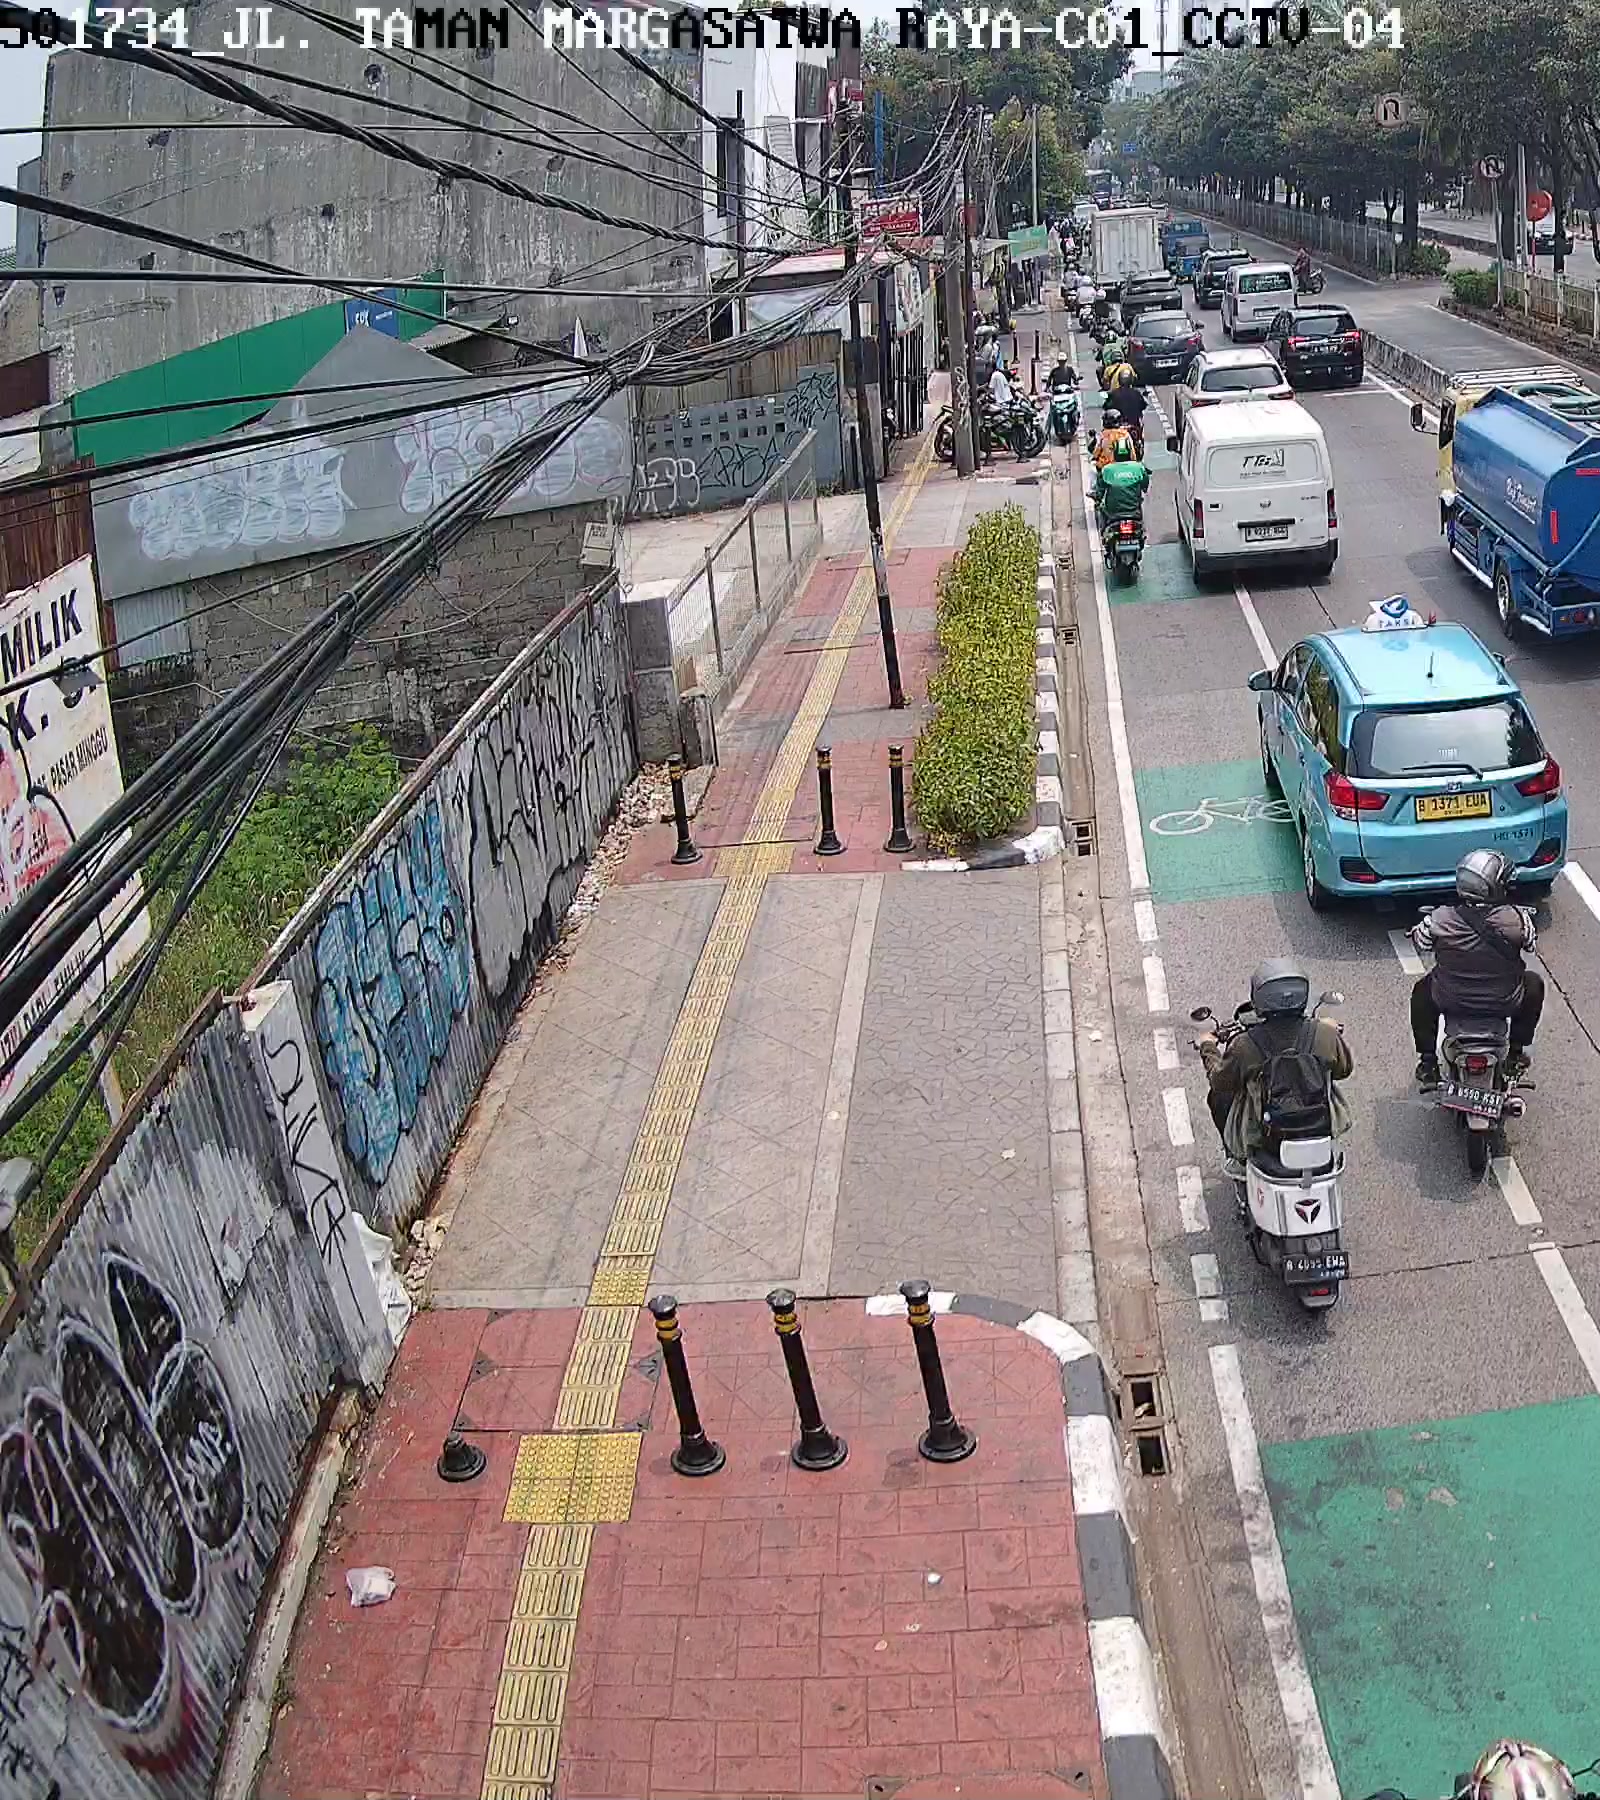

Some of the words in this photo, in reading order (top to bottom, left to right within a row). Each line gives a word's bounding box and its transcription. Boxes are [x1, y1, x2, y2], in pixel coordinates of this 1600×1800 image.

[0, 587, 83, 684] MILIK
[51, 750, 78, 794] PASAR
[76, 726, 109, 771] MINGGU
[1465, 792, 1487, 808] EUA
